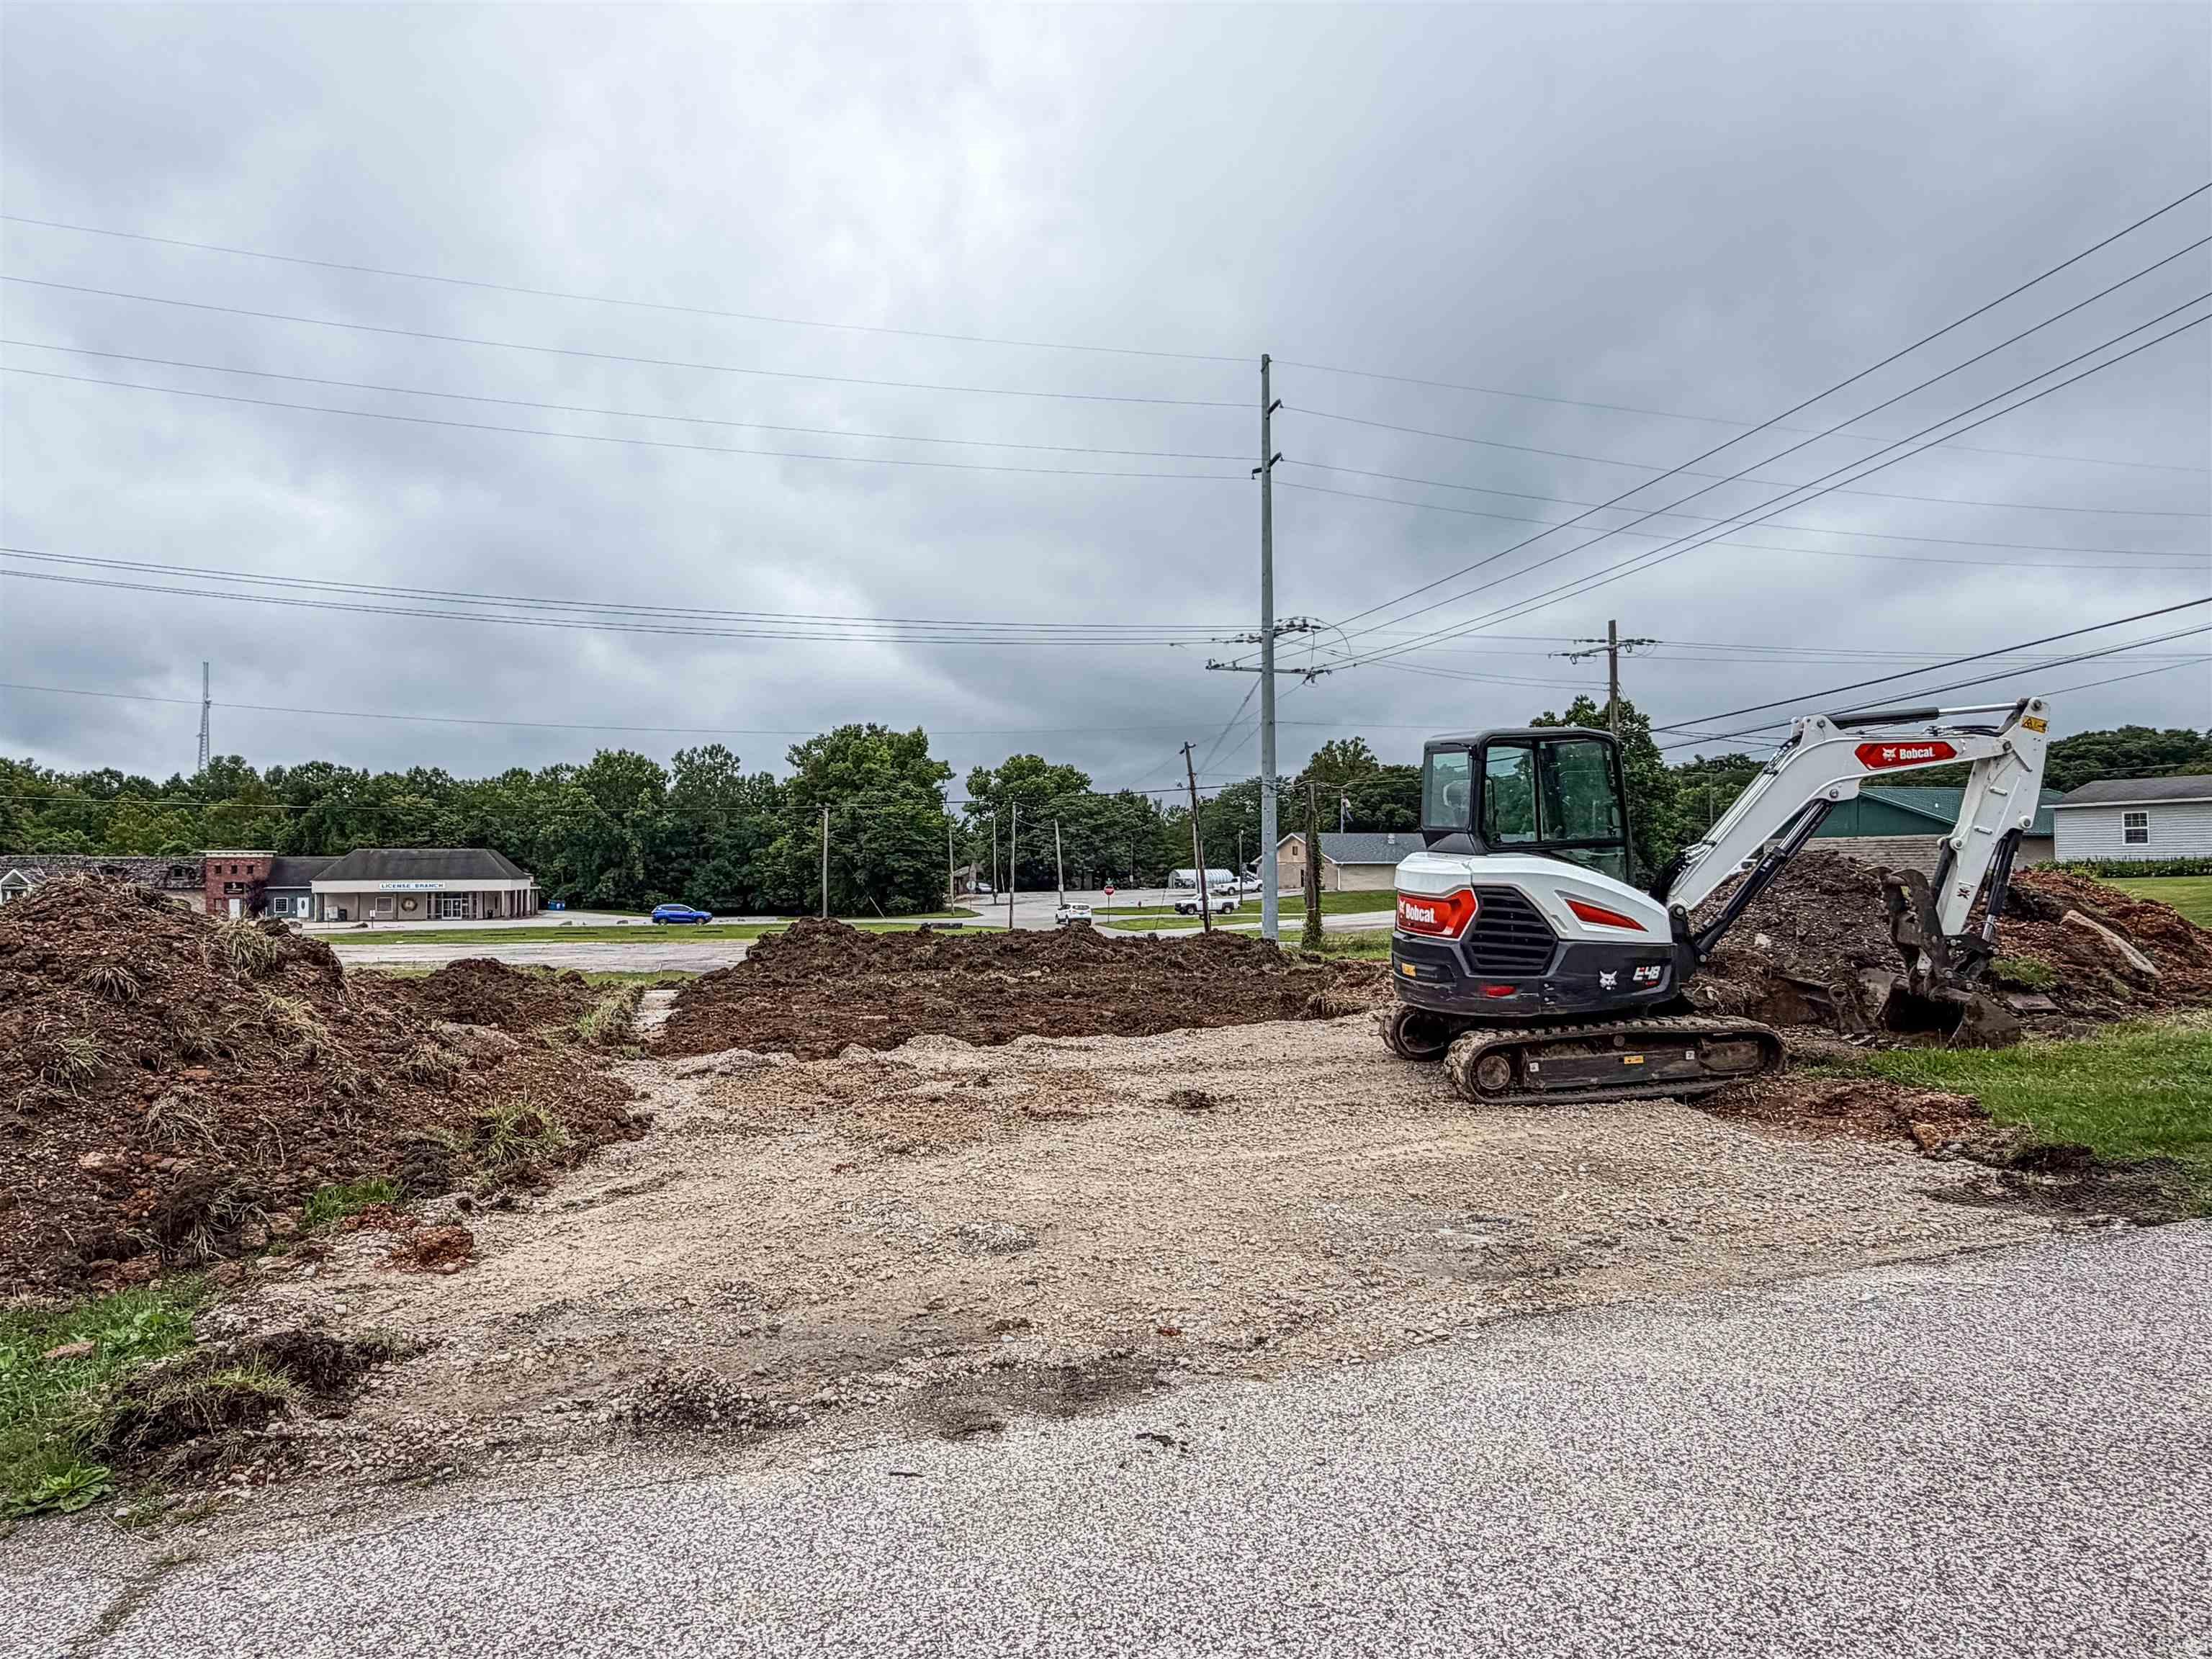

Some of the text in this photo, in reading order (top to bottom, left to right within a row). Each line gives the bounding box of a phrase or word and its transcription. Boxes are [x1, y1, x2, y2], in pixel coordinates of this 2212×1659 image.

[1899, 747, 1933, 760] Bobcat
[1406, 904, 1435, 923] Bobcat
[1633, 966, 1660, 981] E48
